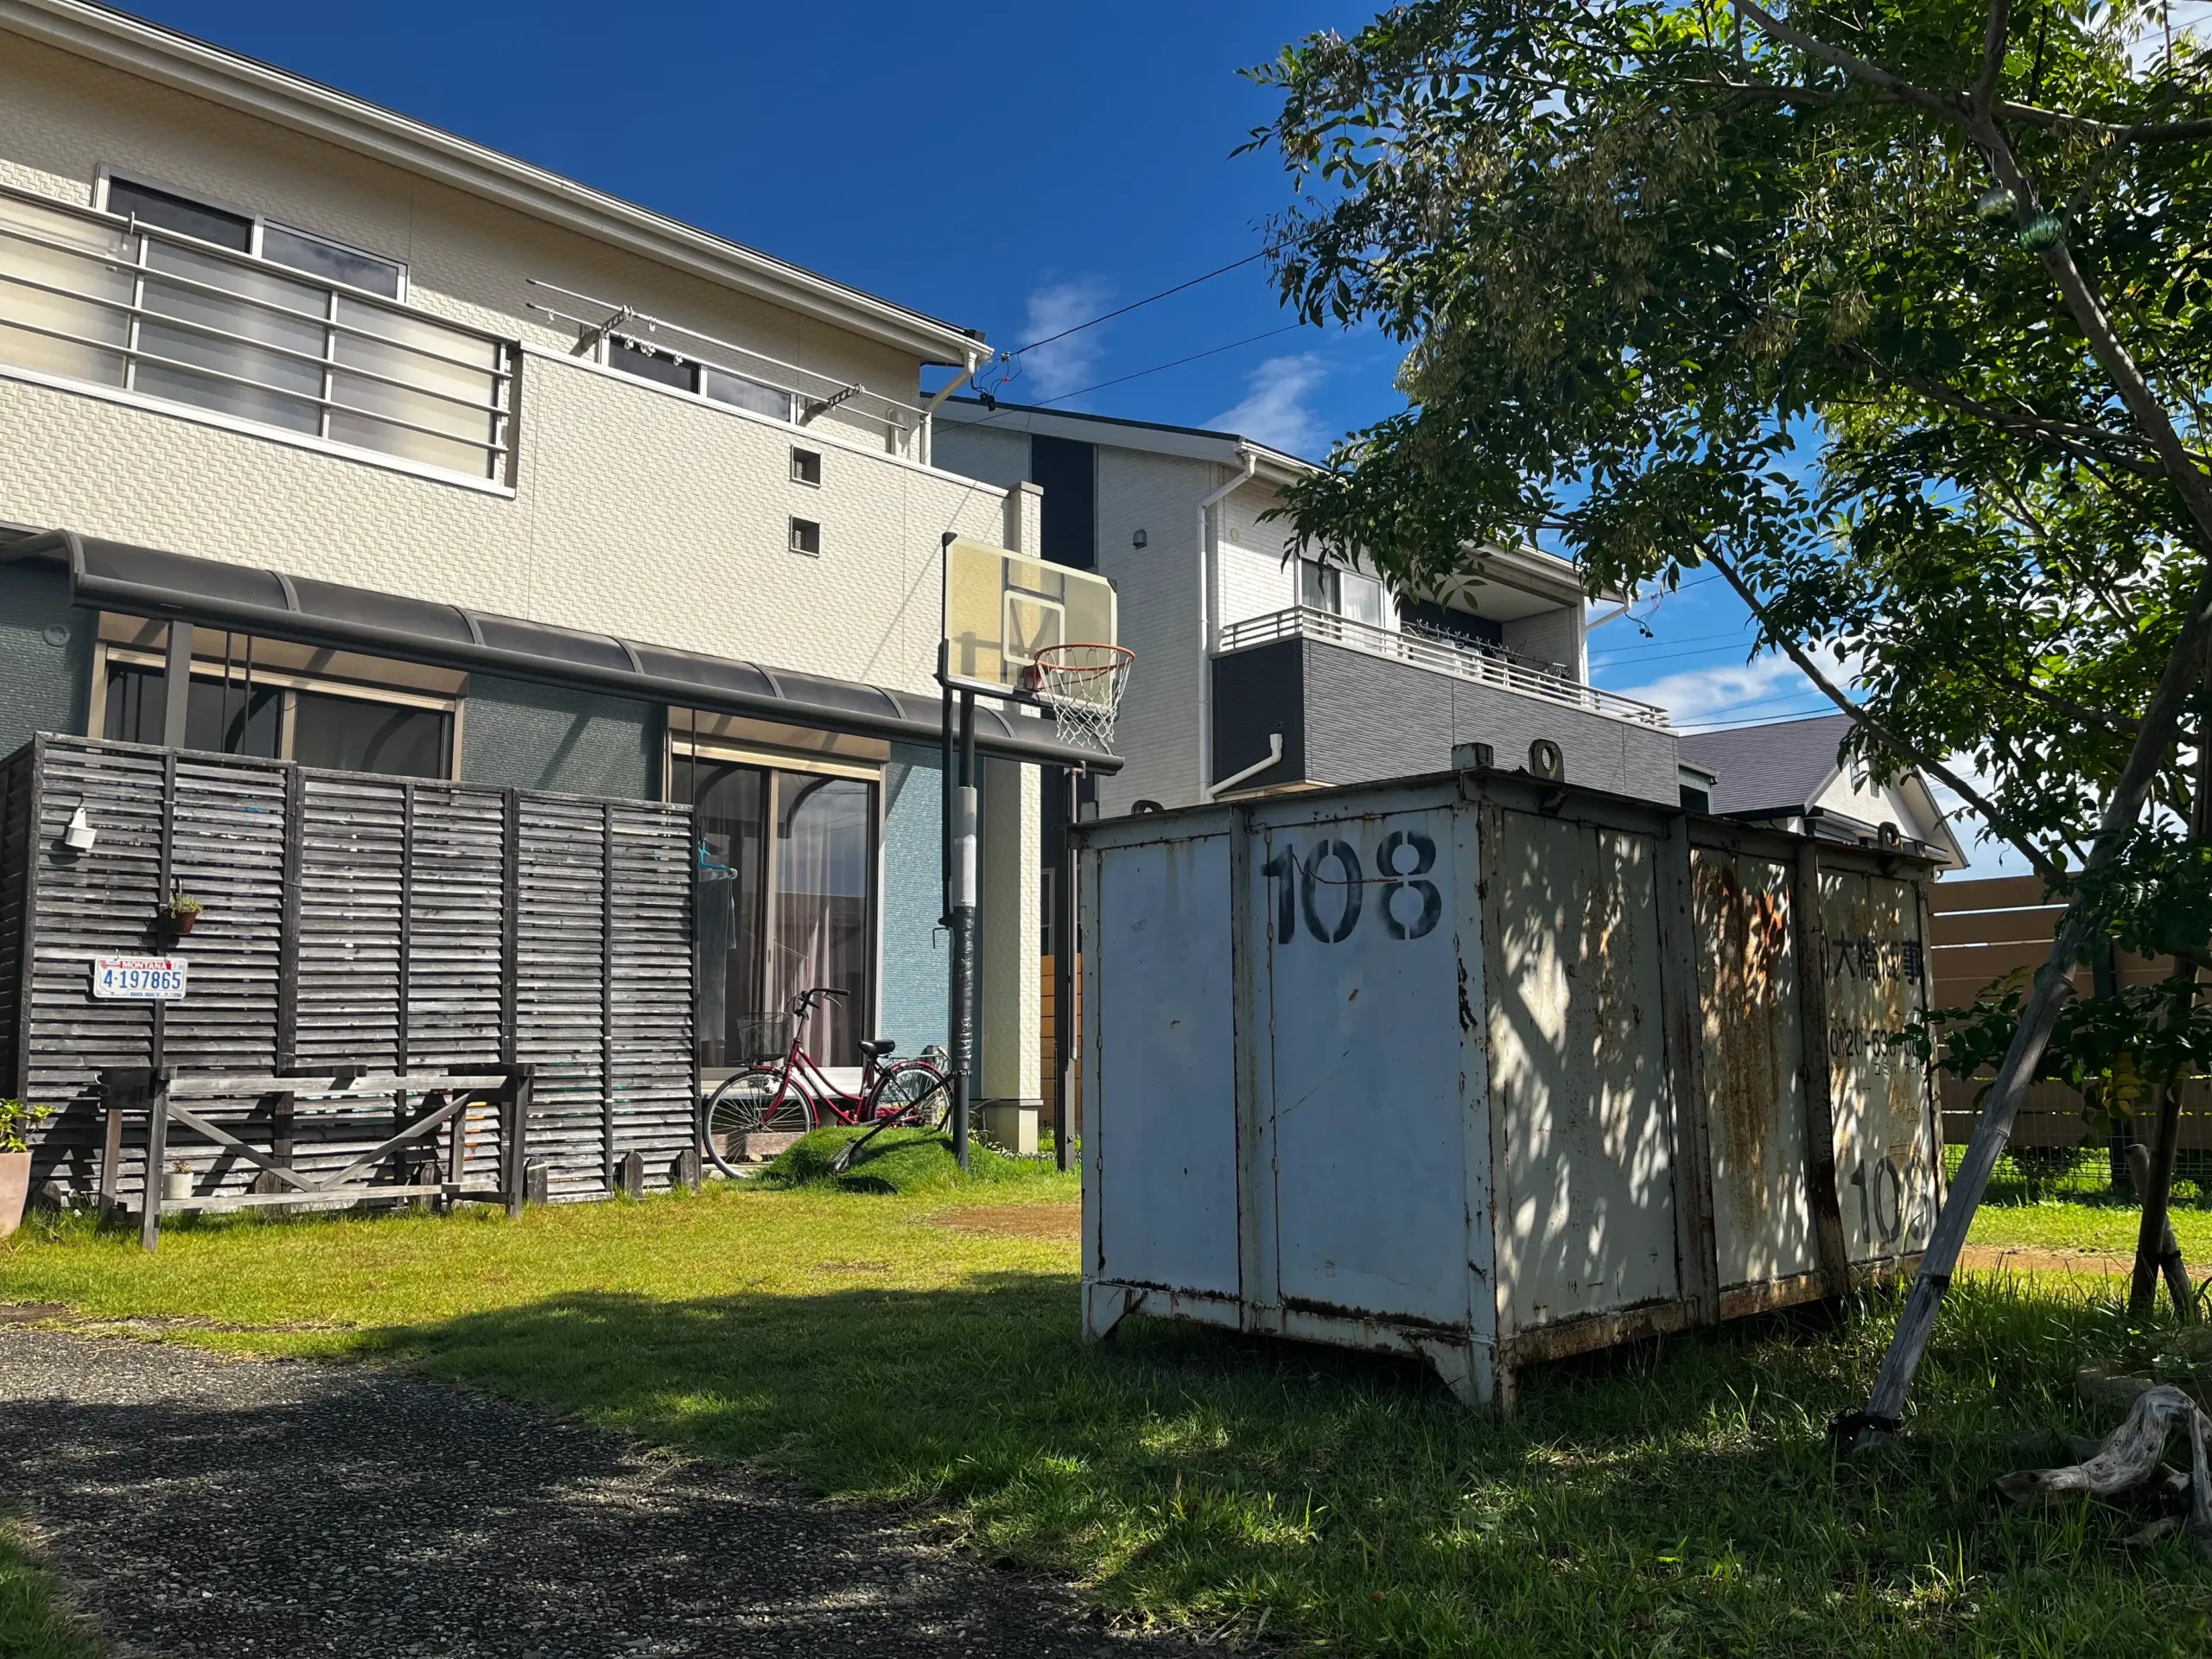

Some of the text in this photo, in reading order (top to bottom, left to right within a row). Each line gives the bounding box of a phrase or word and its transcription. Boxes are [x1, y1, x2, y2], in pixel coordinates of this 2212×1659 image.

[1261, 830, 1442, 945] 108
[123, 961, 167, 969] MONTANA
[1851, 1156, 1932, 1243] 108
